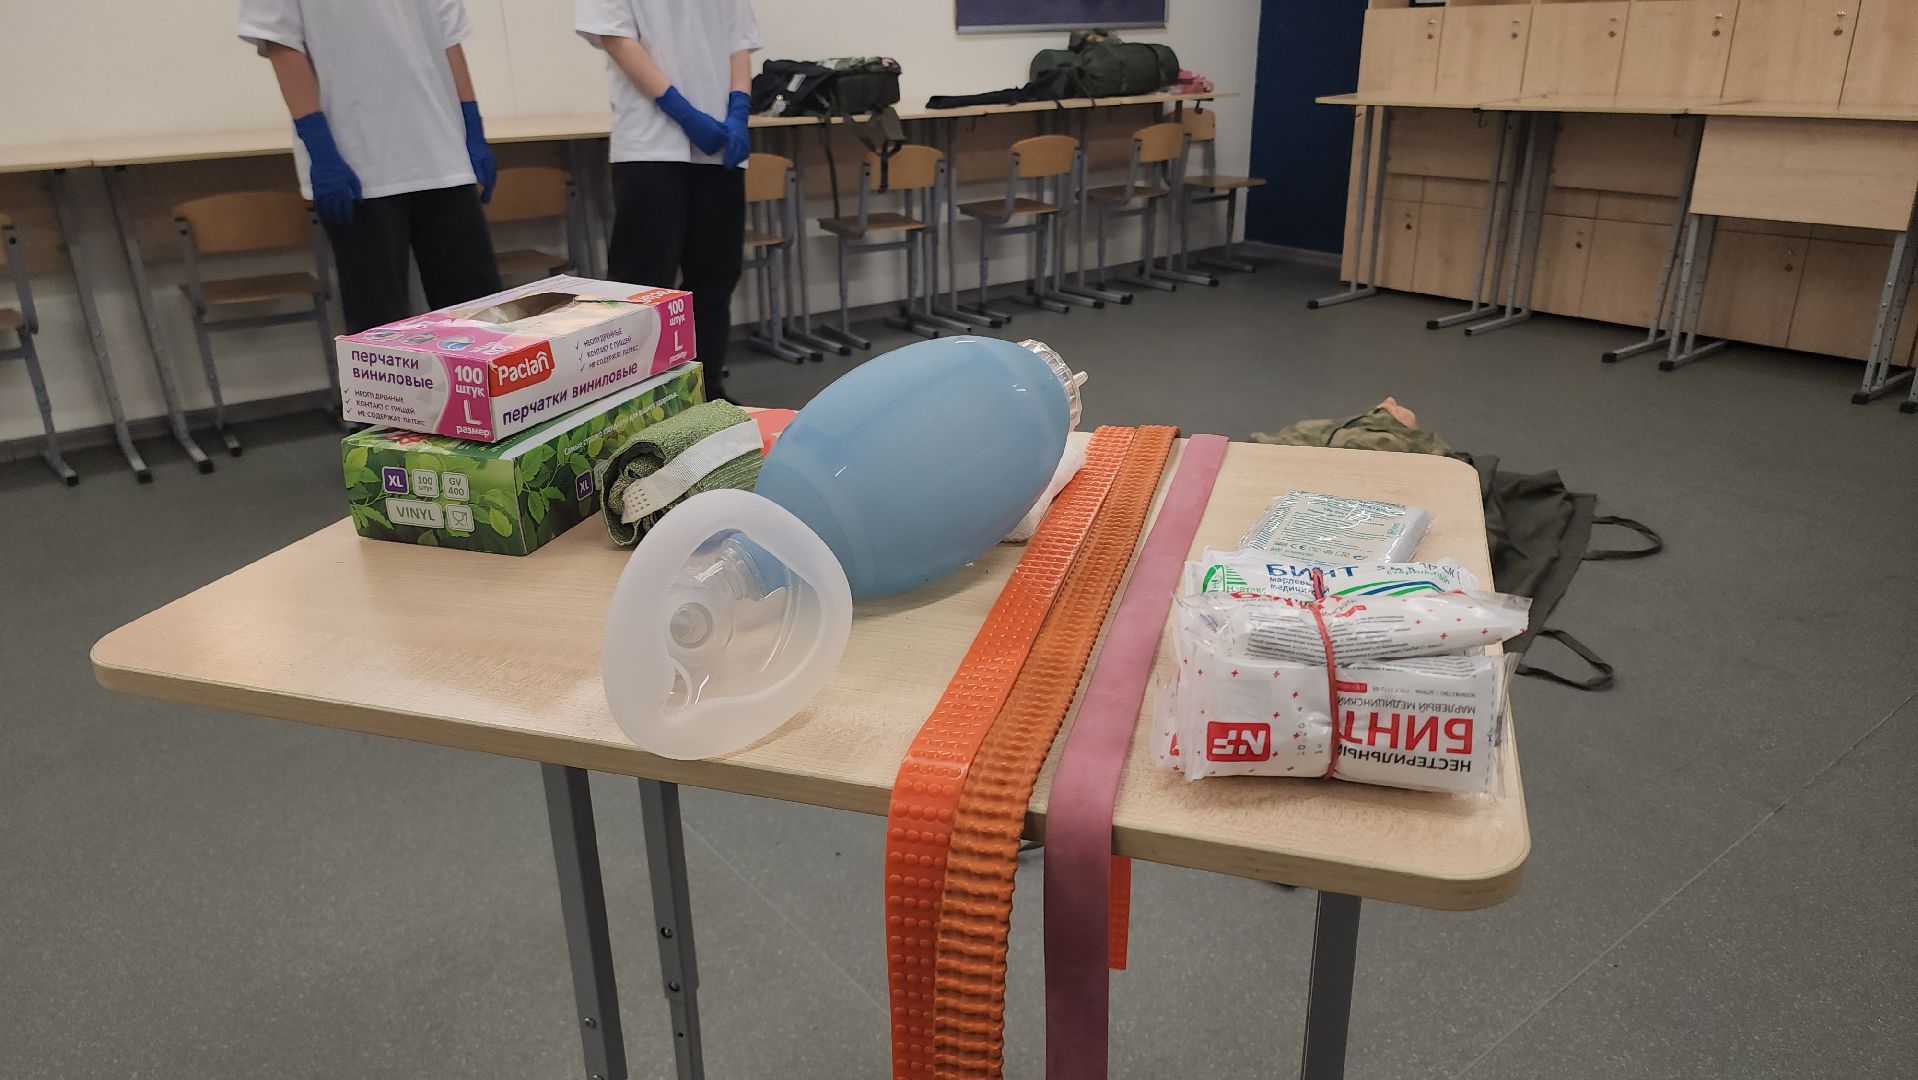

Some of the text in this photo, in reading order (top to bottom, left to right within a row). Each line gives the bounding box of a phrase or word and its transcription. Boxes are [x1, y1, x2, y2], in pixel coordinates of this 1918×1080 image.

[668, 298, 685, 316] 100
[670, 314, 686, 326] штук
[674, 330, 683, 352] L
[352, 350, 419, 370] перчатки
[498, 351, 551, 386] Paclan
[353, 368, 434, 389] виниловые
[454, 365, 484, 385] 100
[455, 384, 486, 399] штук
[502, 362, 639, 425] перчатки виниловые
[463, 399, 483, 425] L
[456, 425, 490, 439] размер
[387, 474, 404, 487] XL
[418, 476, 432, 485] 100
[449, 477, 461, 486] GV
[579, 480, 589, 494] XL
[448, 487, 464, 496] 400
[396, 505, 435, 521] VINYL
[1266, 563, 1359, 581] БИНТ
[1418, 701, 1476, 715] МАРЛЕВЫЙ
[1339, 711, 1473, 754] БИНТ
